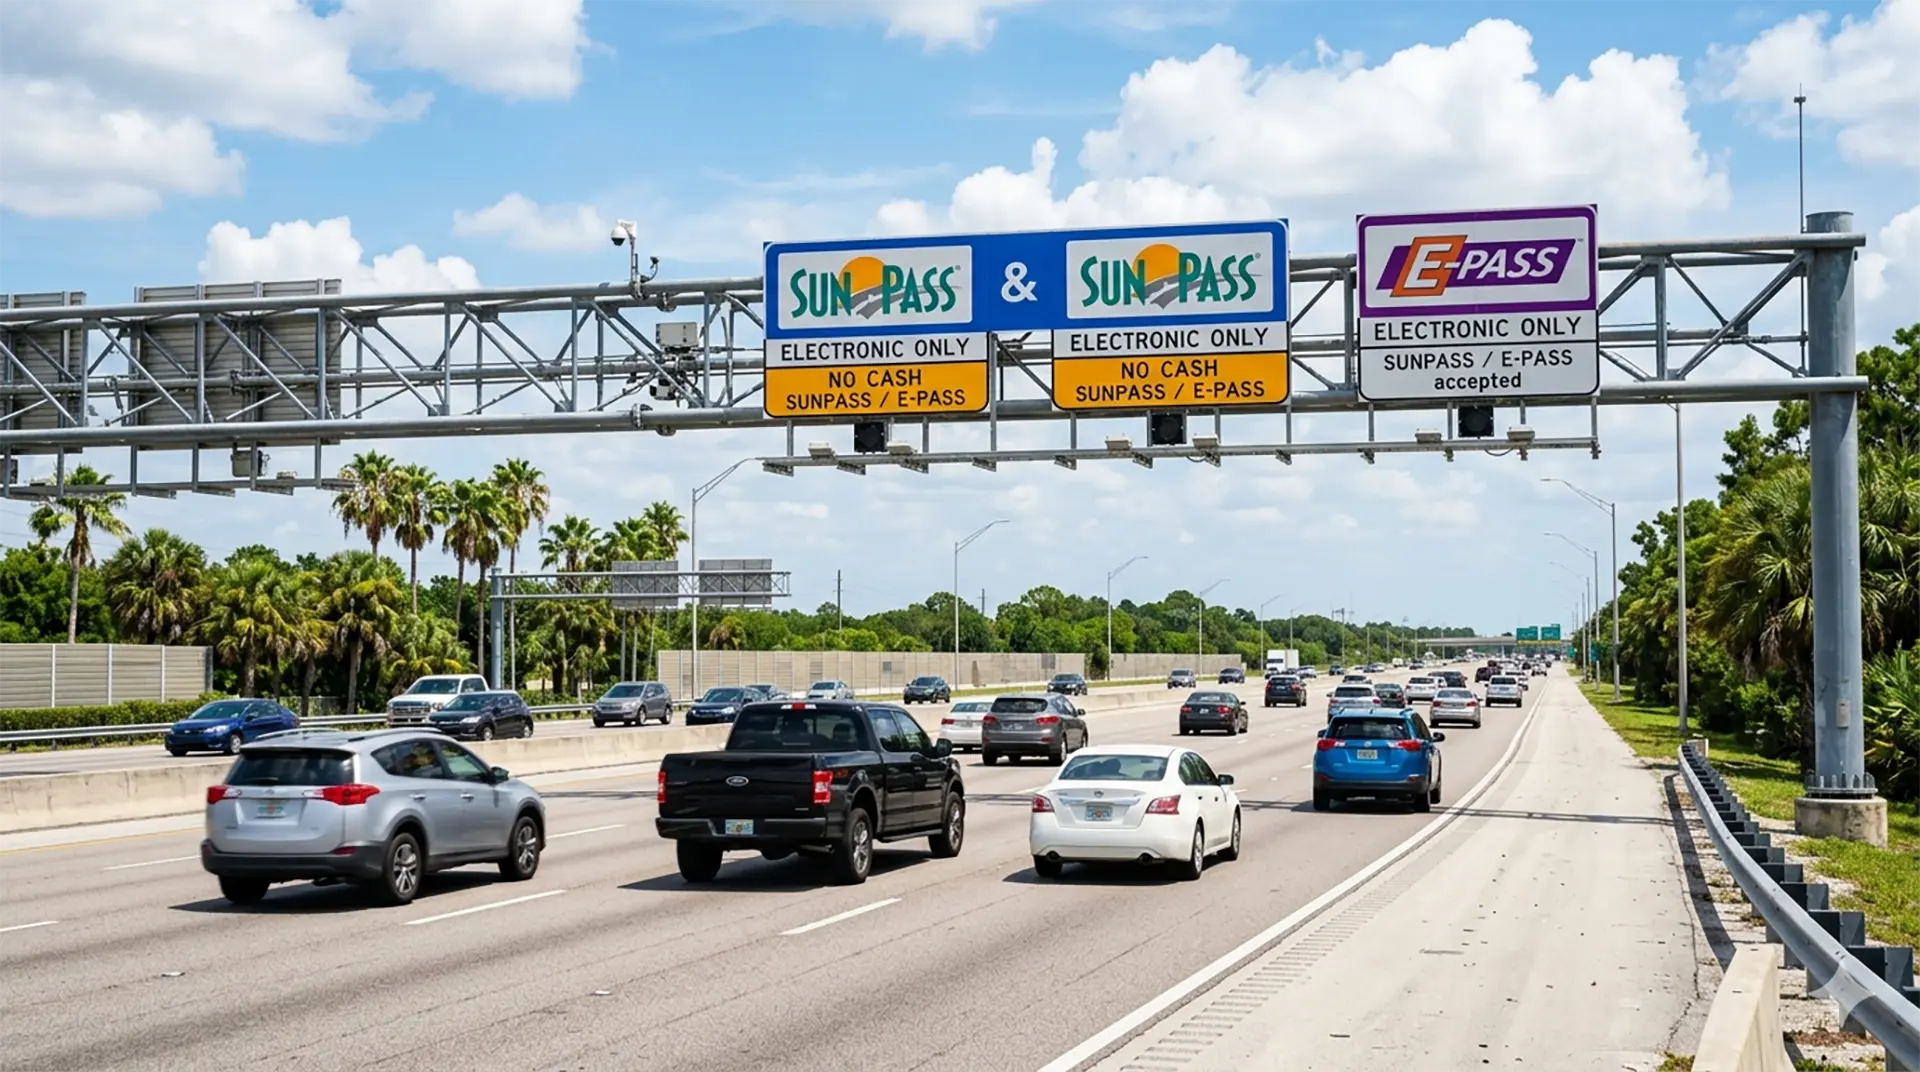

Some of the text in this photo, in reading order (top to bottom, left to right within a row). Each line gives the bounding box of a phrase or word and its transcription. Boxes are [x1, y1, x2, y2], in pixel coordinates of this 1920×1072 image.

[1402, 243, 1560, 289] E-PASS
[790, 265, 957, 318] SUN PASS
[1001, 261, 1038, 303] &
[1080, 252, 1257, 308] SUN PASS
[1070, 327, 1269, 352] ELECTRONIC ONLY
[1374, 316, 1582, 341] ELECTRONIC ONLY
[781, 337, 970, 361] ELECTRONIC ONLY
[1384, 349, 1574, 371] SUNPASS / E-PASS
[828, 368, 922, 388] NO CASH
[1121, 359, 1218, 379] NO CASH
[1075, 380, 1265, 403] SUNPASS / E-PASS
[1433, 372, 1522, 393] accepted
[786, 389, 966, 411] SUNPASS / E-PASS
